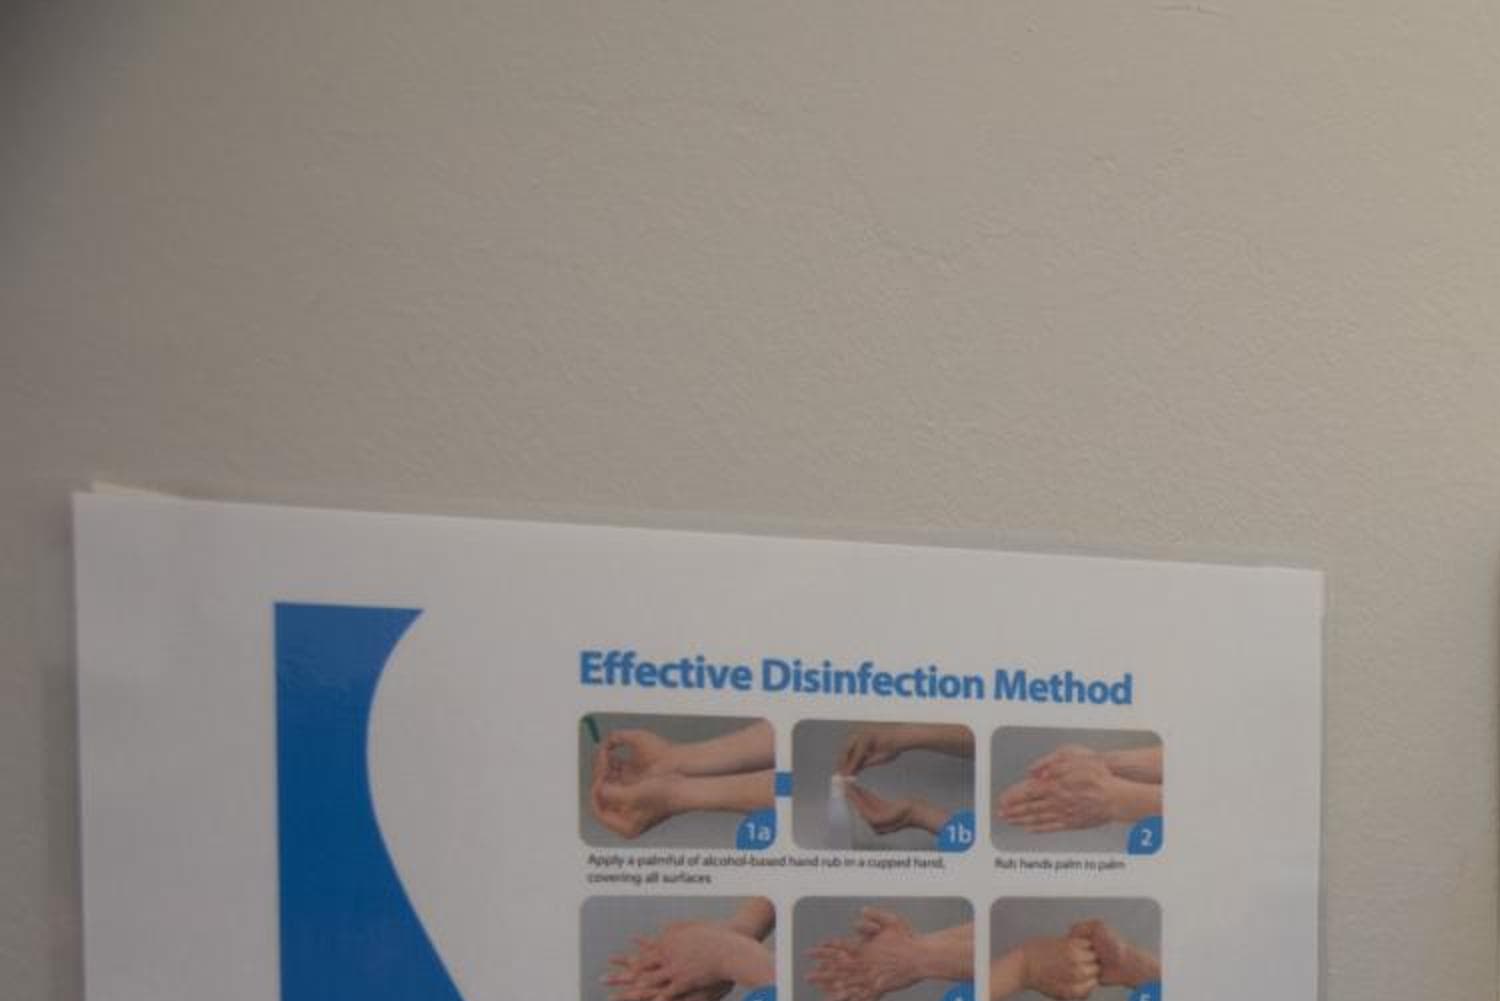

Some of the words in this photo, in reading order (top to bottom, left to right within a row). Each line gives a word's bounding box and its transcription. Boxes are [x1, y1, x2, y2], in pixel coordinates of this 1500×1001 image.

[580, 650, 753, 691] Effective
[761, 658, 984, 699] Disinfection
[994, 668, 1133, 706] Method
[748, 821, 771, 842] 1a
[947, 821, 972, 844] 1b
[1140, 828, 1153, 847] 2
[588, 854, 623, 868] Apply
[637, 854, 685, 868] palmful
[687, 854, 700, 866] of
[788, 855, 819, 867] hand
[868, 856, 911, 870] cupped
[588, 872, 641, 886] covering
[645, 871, 659, 883] all
[663, 872, 712, 884] surfaces
